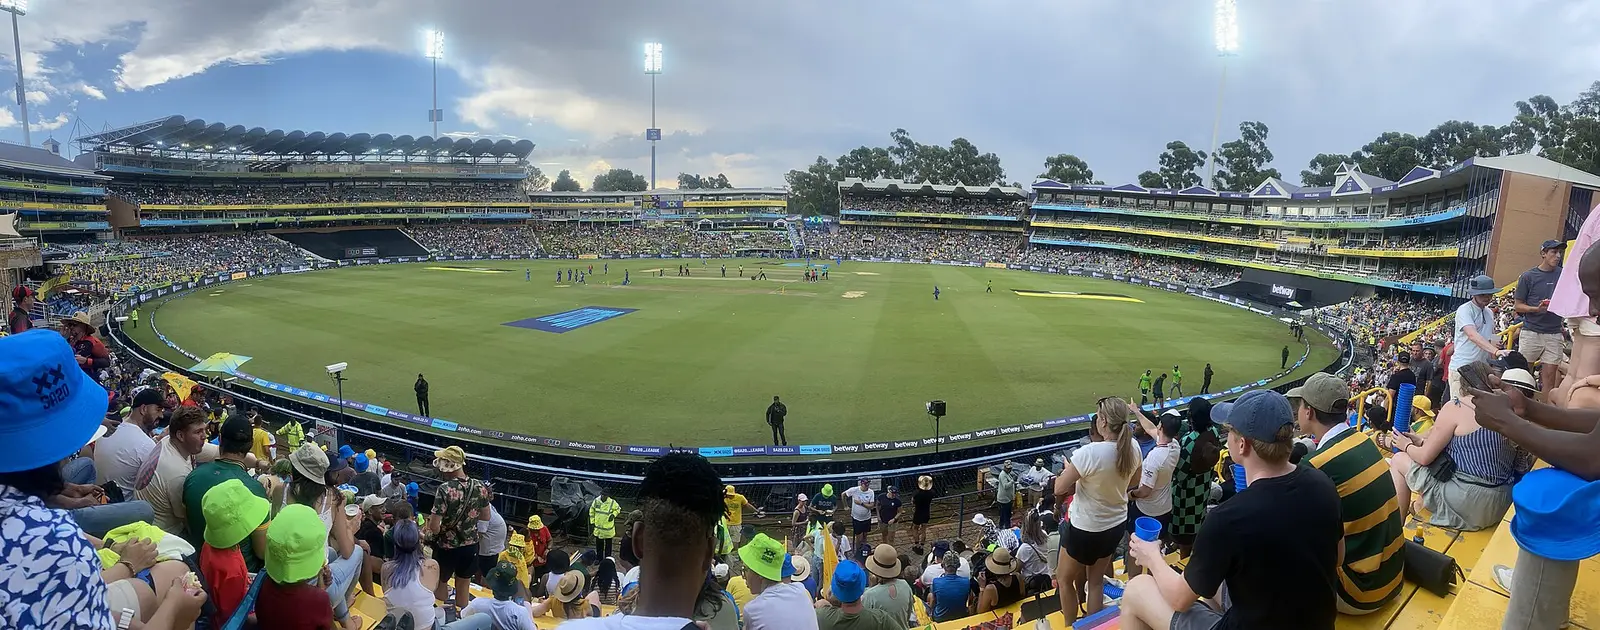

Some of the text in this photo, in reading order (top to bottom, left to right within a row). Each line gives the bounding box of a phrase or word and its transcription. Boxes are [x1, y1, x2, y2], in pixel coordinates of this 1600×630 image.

[1272, 284, 1294, 298] betway
[40, 383, 69, 409] SA20
[1001, 425, 1020, 433] betway
[1024, 422, 1043, 430] betway
[457, 426, 482, 435] zoho.com
[975, 428, 997, 436] betway
[923, 437, 945, 445] betway
[949, 433, 971, 441] betway
[568, 441, 596, 449] zoho.com
[833, 444, 859, 452] betway
[864, 442, 888, 450] betway
[894, 441, 918, 449] betway
